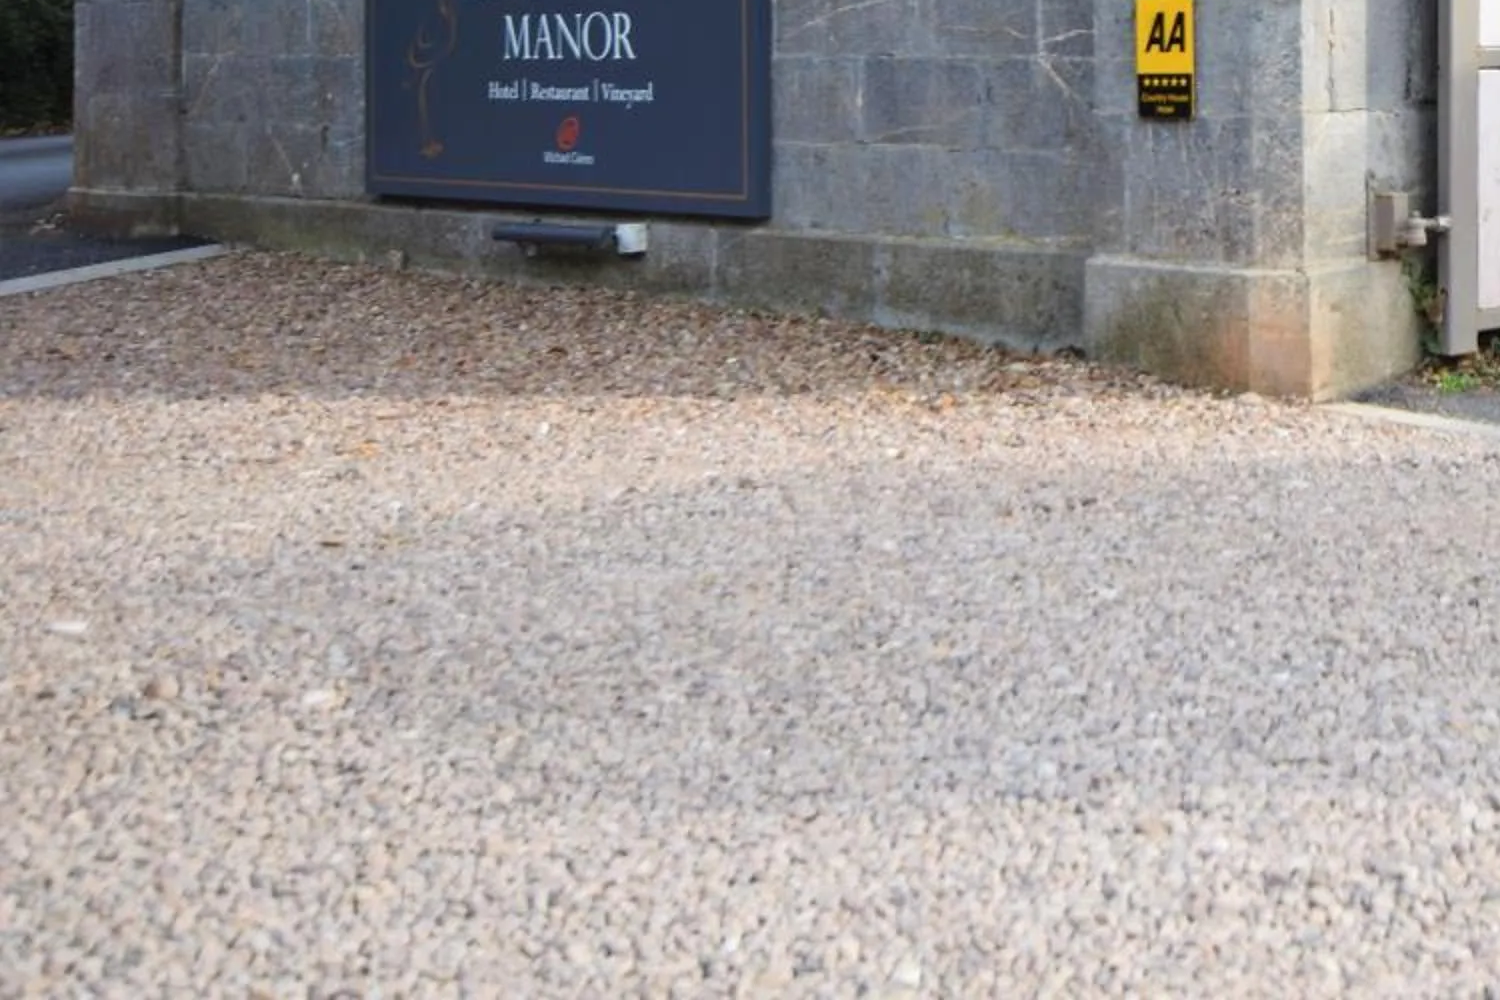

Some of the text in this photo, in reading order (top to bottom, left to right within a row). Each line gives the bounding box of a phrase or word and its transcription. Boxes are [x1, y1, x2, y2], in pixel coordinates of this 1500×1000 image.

[503, 11, 636, 60] MANOR
[1145, 10, 1186, 53] AA
[488, 80, 653, 109] Hotel Restaurant Vineyard
